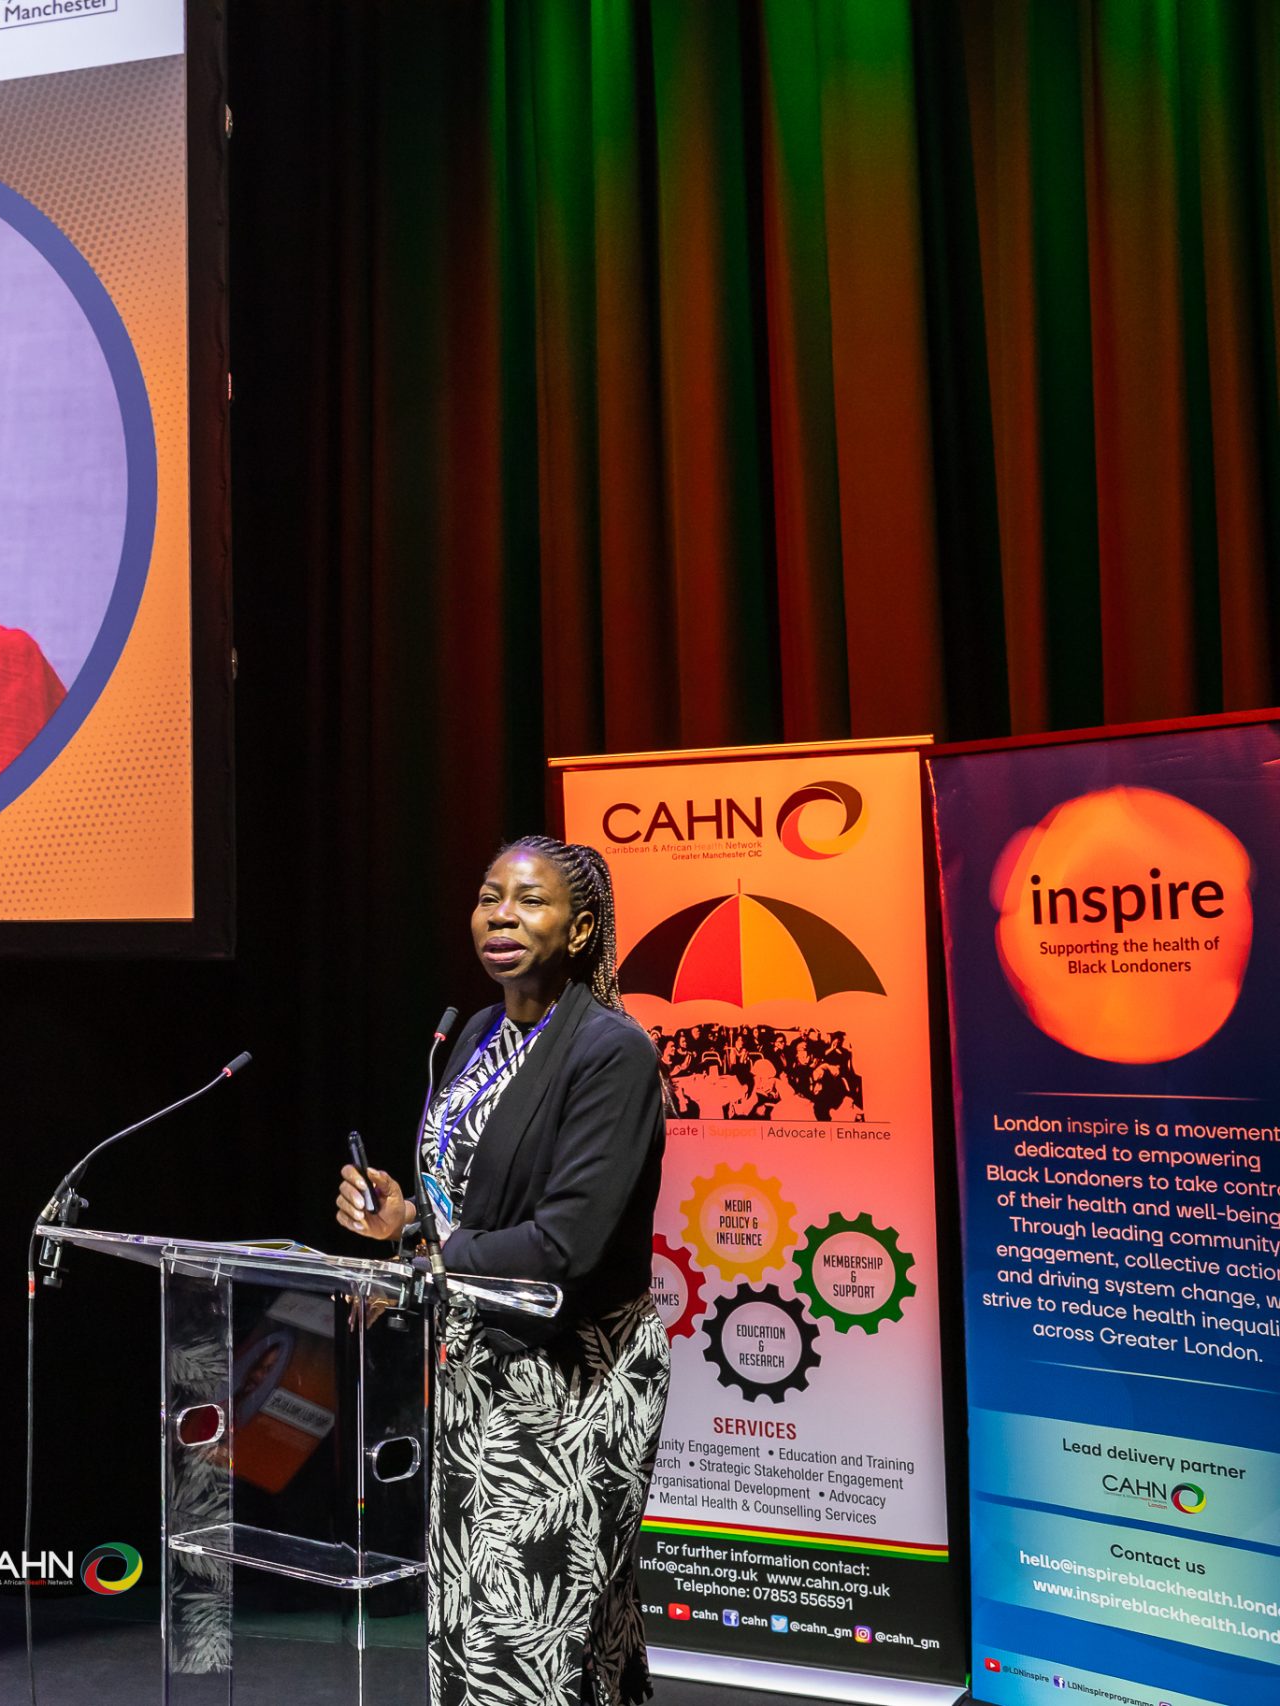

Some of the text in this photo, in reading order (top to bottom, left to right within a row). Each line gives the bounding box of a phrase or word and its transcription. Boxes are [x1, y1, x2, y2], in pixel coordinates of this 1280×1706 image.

[4, 0, 106, 23] Manchester
[602, 796, 764, 844] CAHN
[605, 846, 650, 855] Caribbean
[652, 844, 659, 853] &
[661, 843, 692, 852] African
[725, 840, 763, 850] Network
[671, 849, 762, 861] Greater Manchester CIC
[1030, 867, 1225, 933] inspire
[1039, 935, 1220, 956] Supporting the health of
[1068, 958, 1191, 974] Black Londoners
[767, 1126, 826, 1140] Advocate
[836, 1127, 891, 1141] Enhance
[993, 1114, 1280, 1142] London inspire is a movement
[1014, 1141, 1261, 1173] dedicated to empowering
[986, 1164, 1280, 1198] Black Londoners to take contr
[724, 1199, 752, 1213] MEDIA
[997, 1190, 1280, 1230] of their health and well-being
[716, 1231, 763, 1246] INFLUENCE
[720, 1215, 758, 1230] POLICY &
[1009, 1216, 1280, 1257] Through leading community
[823, 1254, 883, 1270] MEMBERSHIP
[996, 1243, 1119, 1268] engagement,
[1124, 1252, 1220, 1275] collective
[833, 1284, 875, 1299] SUPPORT
[850, 1270, 857, 1283] &
[997, 1268, 1280, 1310] and driving system change, w
[982, 1291, 1280, 1337] strive to reduce health inequali
[736, 1324, 786, 1340] EDUCATION
[758, 1339, 765, 1352] &
[1032, 1322, 1263, 1363] across Greater London.
[739, 1352, 785, 1368] RESEARCH
[713, 1416, 797, 1440] SERVICES
[658, 1438, 915, 1475] unity Engagement Education and Training
[1062, 1438, 1246, 1480] Lead delivery partner
[656, 1456, 903, 1490] arch Strategic Stakeholder Engagement
[1102, 1474, 1167, 1501] CAHN
[650, 1473, 886, 1509] Organisational Development Advocacy
[659, 1491, 877, 1525] Mental Health & Counselling Services
[656, 1541, 870, 1577] For further information contact:
[1110, 1543, 1206, 1576] Contact us
[639, 1557, 891, 1597] info@cahn.org.uk www.cahn.org.uk
[1020, 1549, 1280, 1619] hello@inspireblackhealth.lond
[673, 1577, 854, 1611] Telephone: 07853 556591
[649, 1605, 663, 1614] on
[692, 1609, 719, 1621] cahn
[741, 1615, 768, 1627] cahn
[790, 1620, 853, 1638] @cahn_gm
[875, 1631, 940, 1649] @cahn_gm
[1033, 1578, 1280, 1645] www.inspireblackhealth.lond
[1002, 1664, 1050, 1684] @LDNinspire
